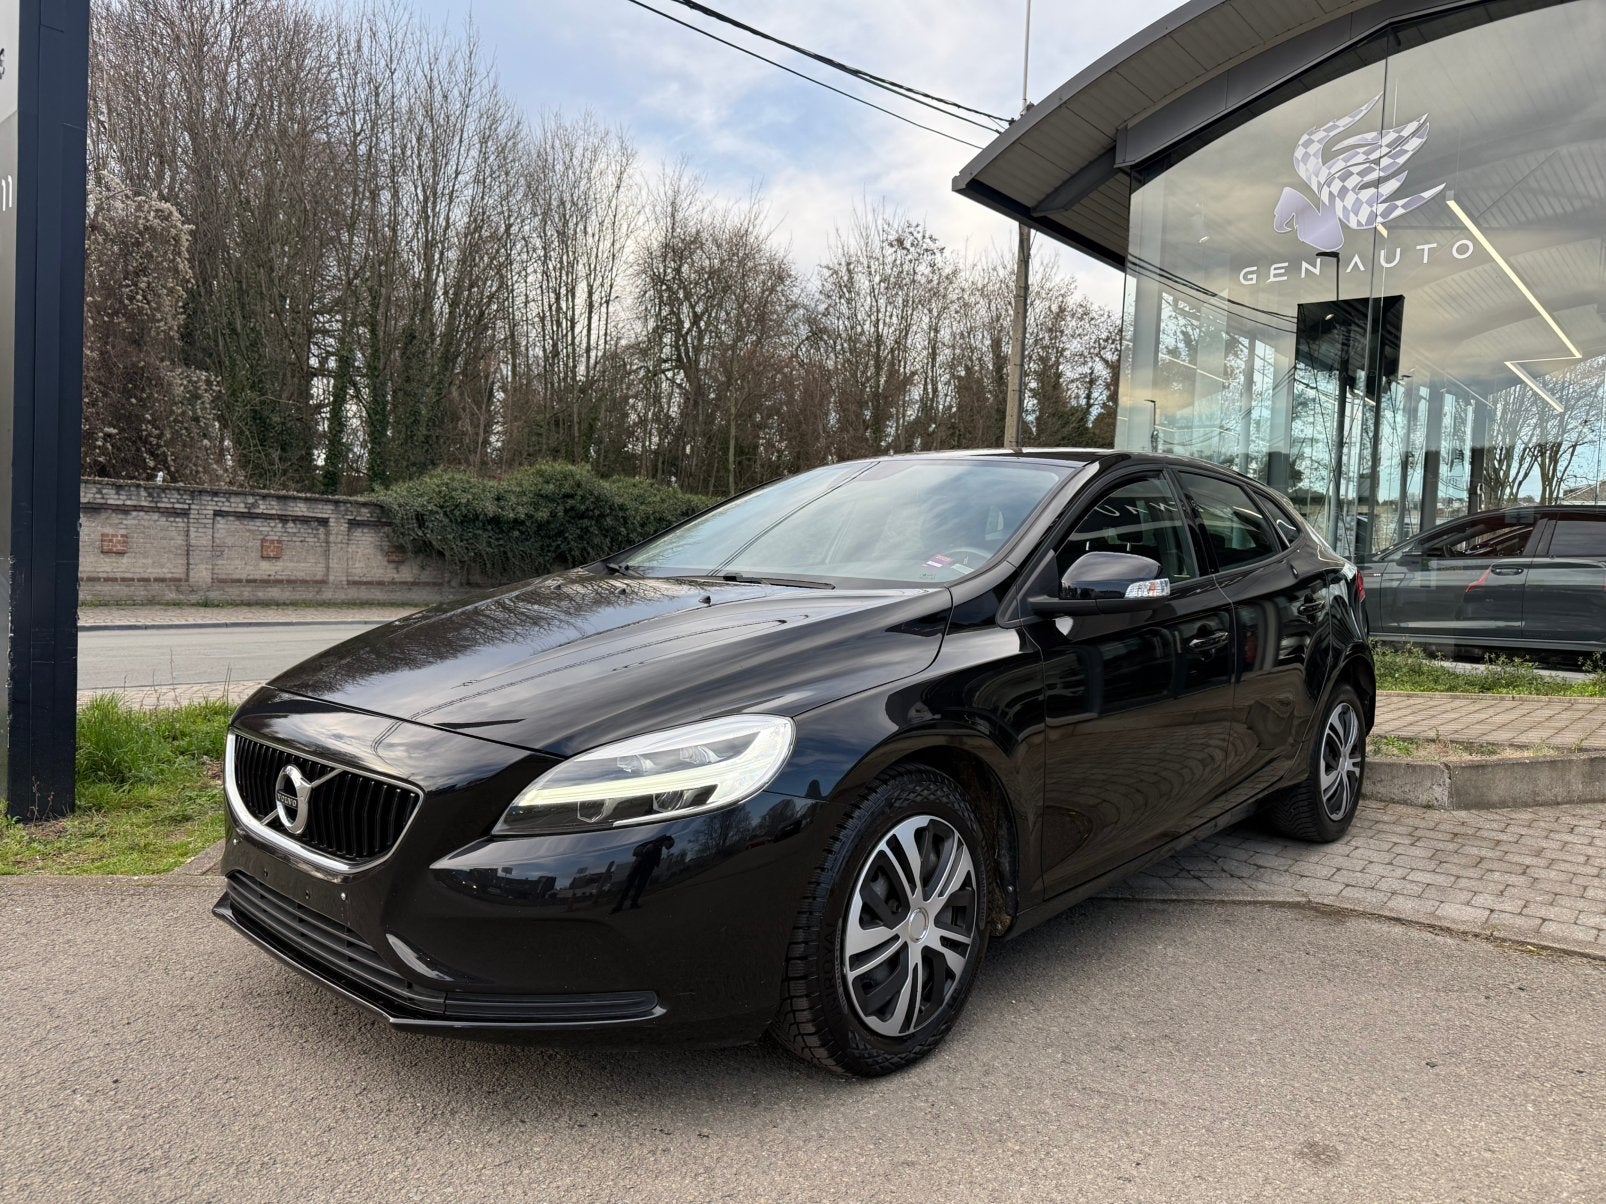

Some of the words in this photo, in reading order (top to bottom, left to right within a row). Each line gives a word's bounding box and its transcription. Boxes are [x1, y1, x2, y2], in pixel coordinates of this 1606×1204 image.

[1239, 258, 1321, 285] GEN
[1346, 239, 1474, 273] AUTO
[277, 793, 297, 807] VOLVO
